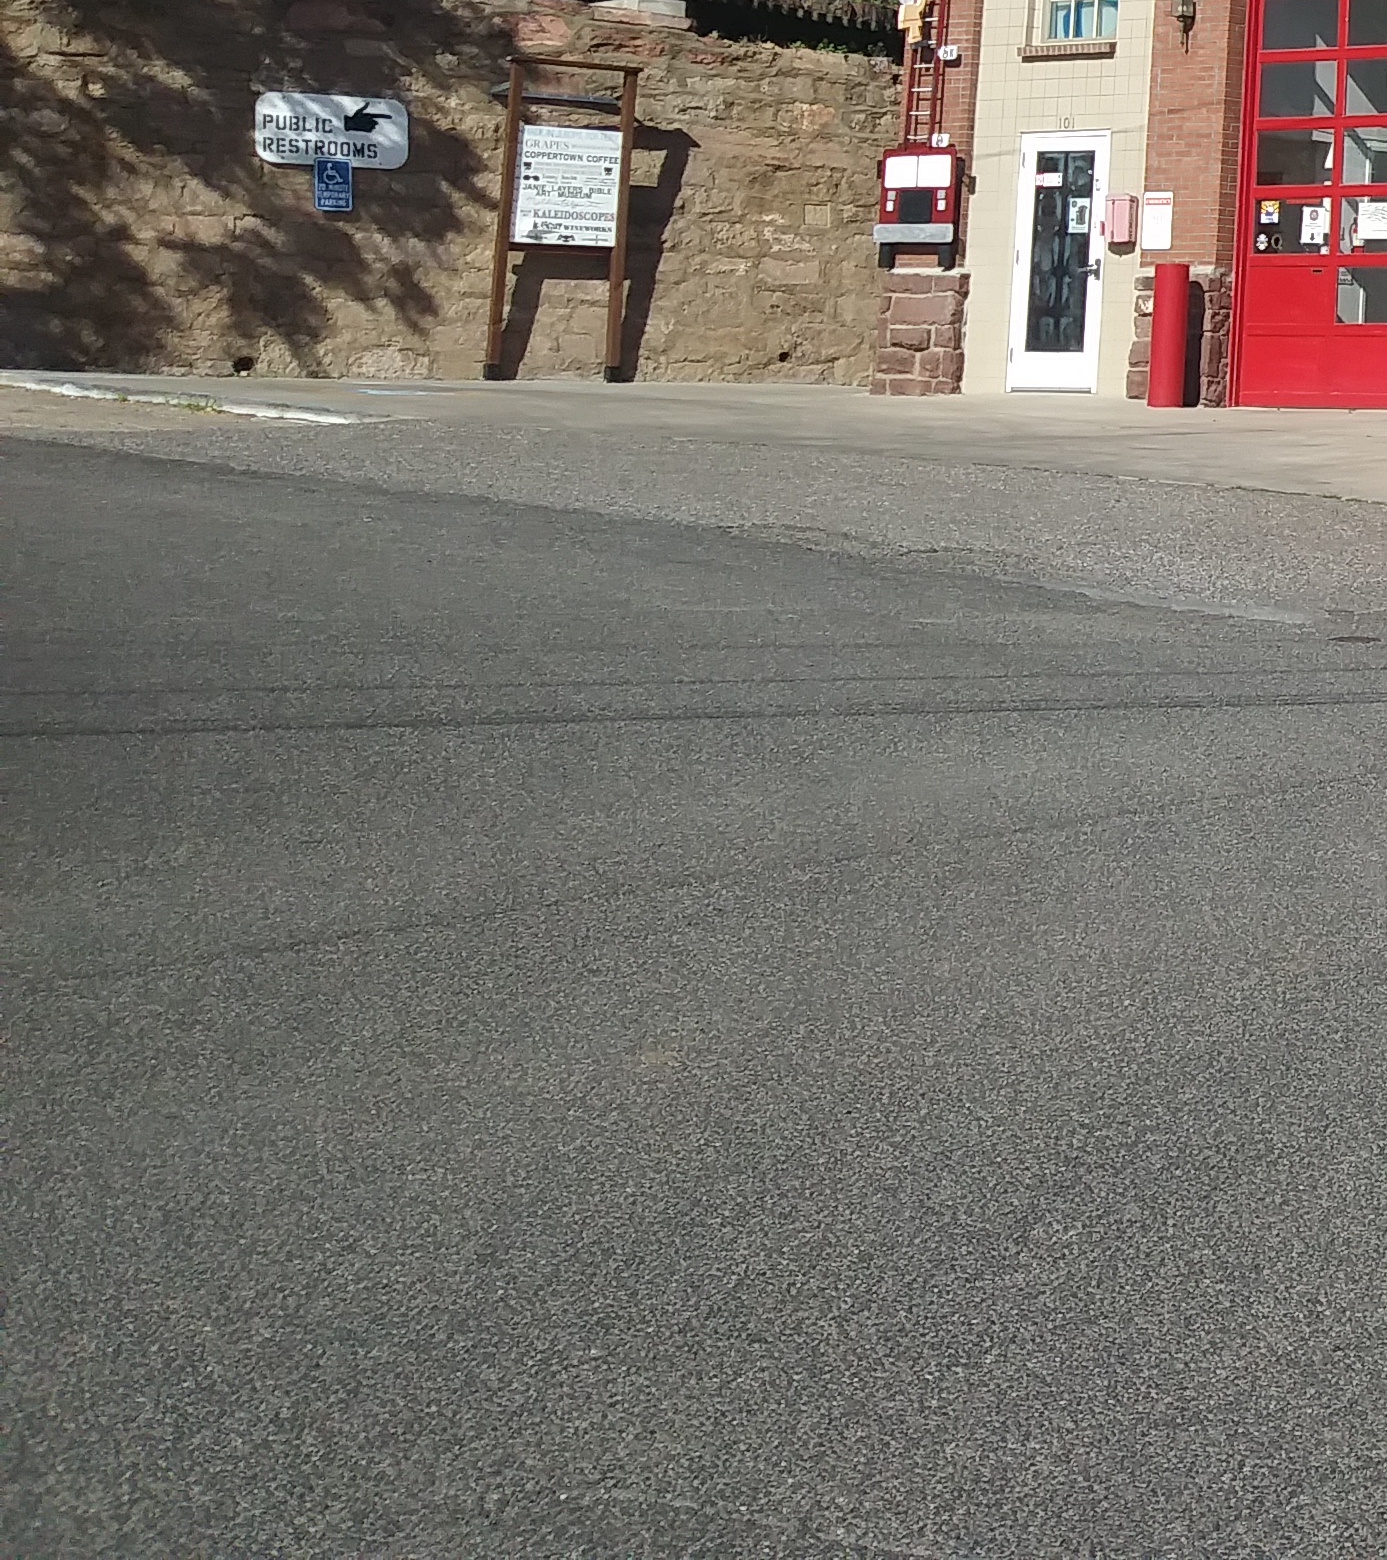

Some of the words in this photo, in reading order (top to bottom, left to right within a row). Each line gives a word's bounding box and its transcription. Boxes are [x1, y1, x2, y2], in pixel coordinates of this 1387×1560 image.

[262, 113, 333, 134] PUBLIC
[1058, 117, 1075, 129] 101
[262, 137, 378, 159] RESTROOMS
[525, 138, 570, 150] GRAPES
[524, 150, 584, 163] COPPERTOWN
[586, 155, 620, 165] COFFEE
[535, 190, 551, 198] ART
[558, 191, 593, 199] MUSEUM
[532, 208, 615, 222] KALEIDOSCOPES
[563, 224, 612, 233] WINEWORKS
